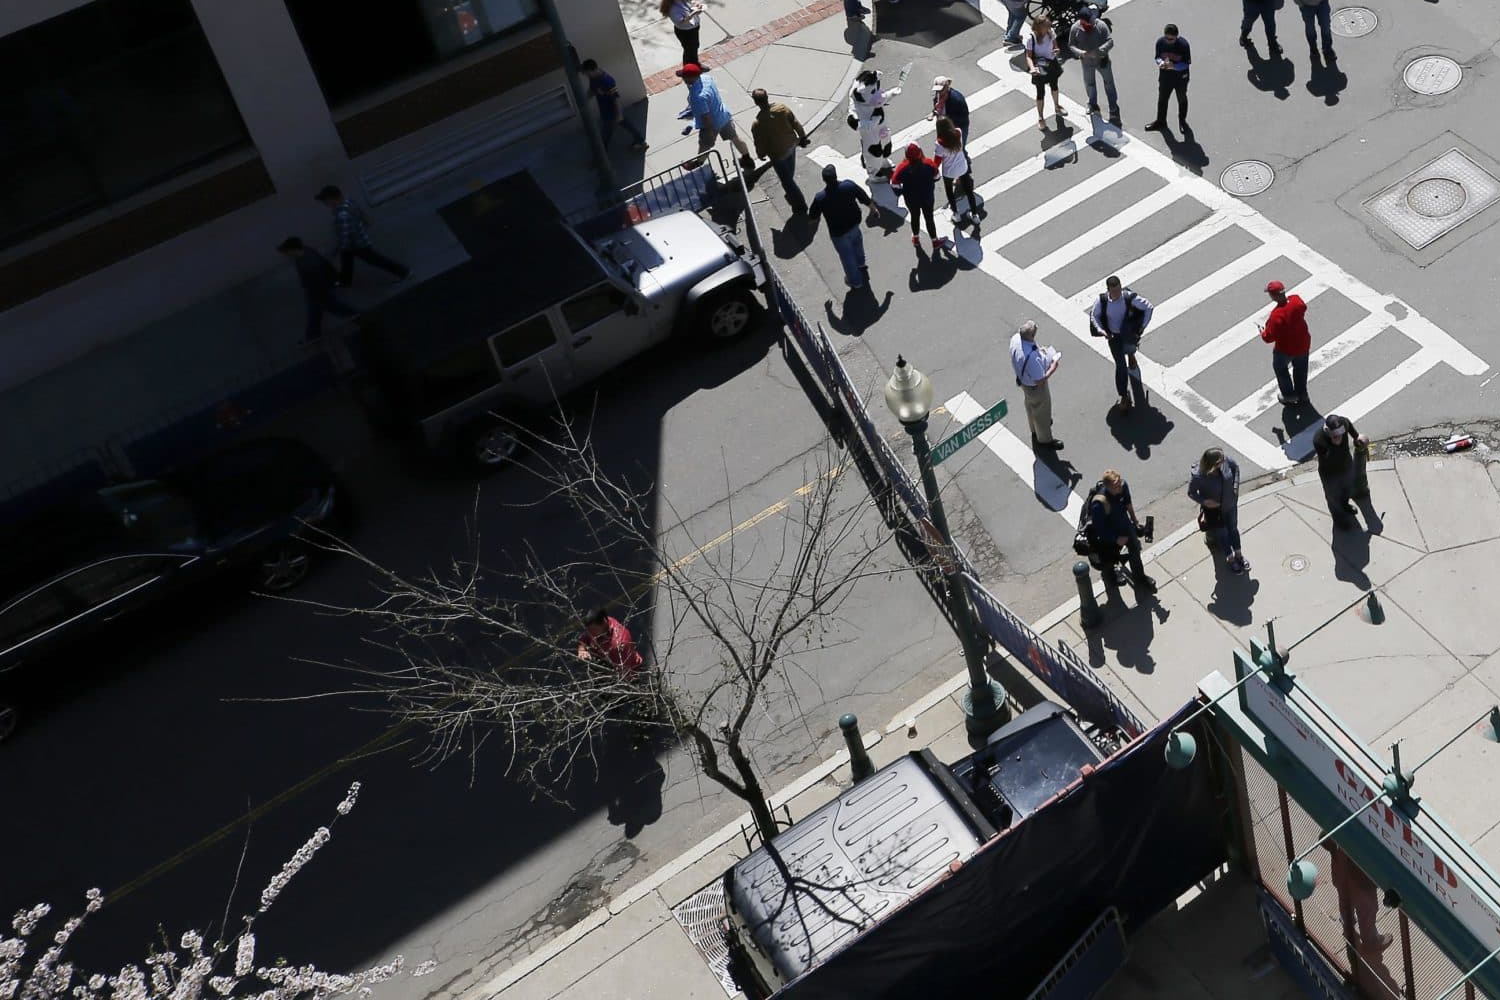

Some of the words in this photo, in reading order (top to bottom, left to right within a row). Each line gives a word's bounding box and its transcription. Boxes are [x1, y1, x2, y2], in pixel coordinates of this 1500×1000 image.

[936, 436, 960, 460] VAN
[962, 413, 992, 443] NESS
[1334, 759, 1424, 859] GATE
[1434, 854, 1458, 889] D
[1337, 783, 1361, 812] NO
[1368, 814, 1459, 909] RE-ENTRY
